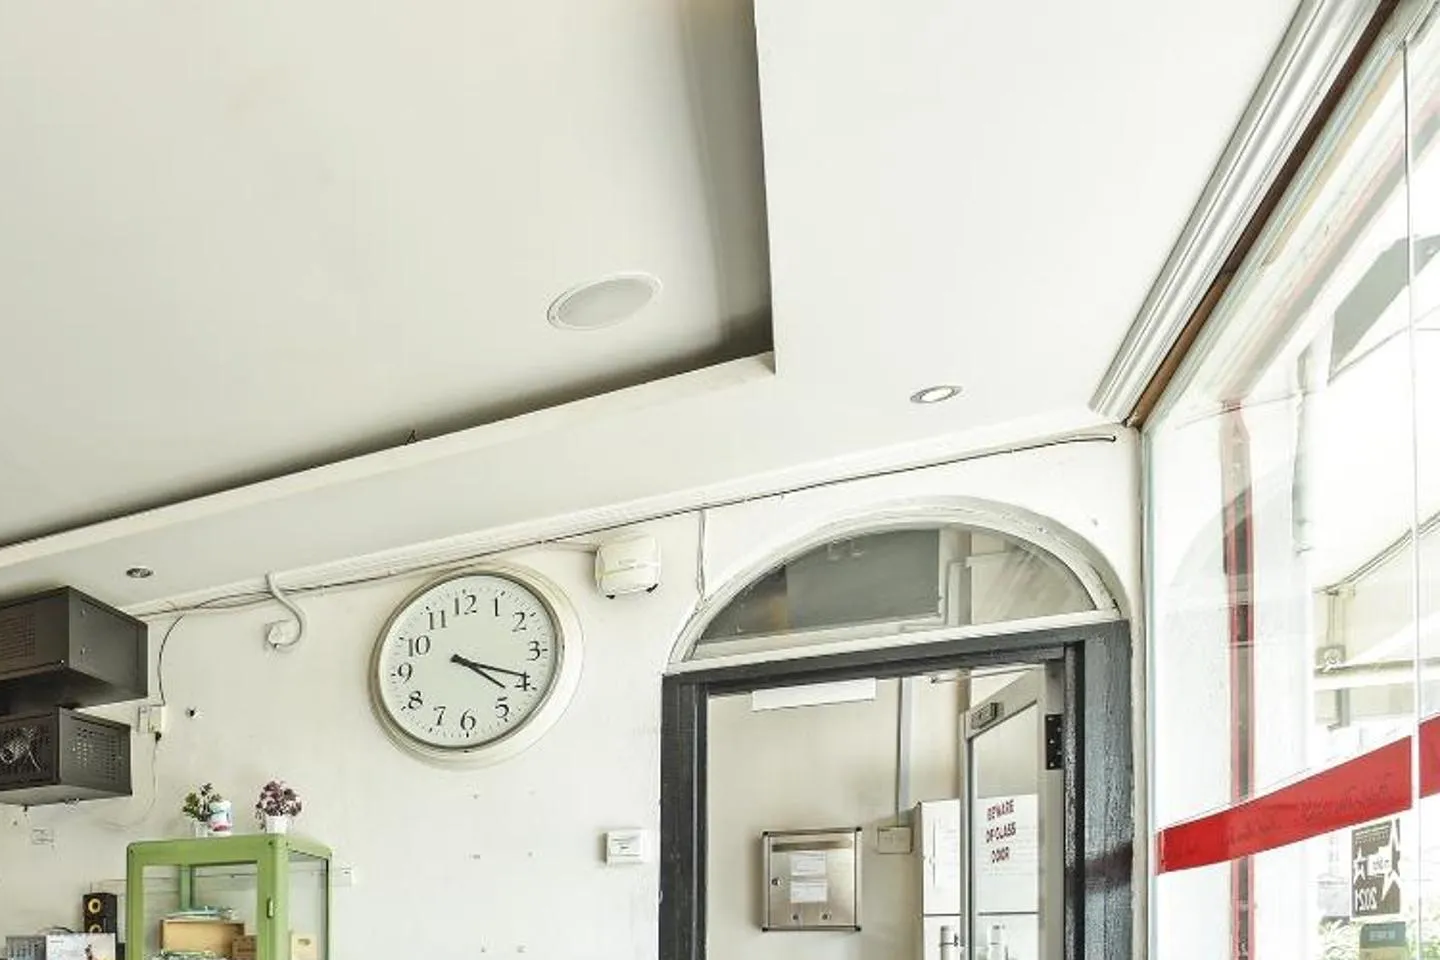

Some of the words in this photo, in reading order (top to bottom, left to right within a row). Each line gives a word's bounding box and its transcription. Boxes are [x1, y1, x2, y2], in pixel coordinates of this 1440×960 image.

[454, 594, 478, 616] 12
[493, 597, 500, 617] 1
[428, 610, 447, 630] 11
[512, 612, 527, 632] 2
[408, 635, 431, 657] 10
[527, 641, 541, 661] 3
[397, 663, 413, 683] 9
[515, 671, 531, 692] 4
[408, 690, 423, 711] 8
[495, 696, 510, 719] 5
[434, 706, 446, 726] 7
[460, 709, 476, 731] 6
